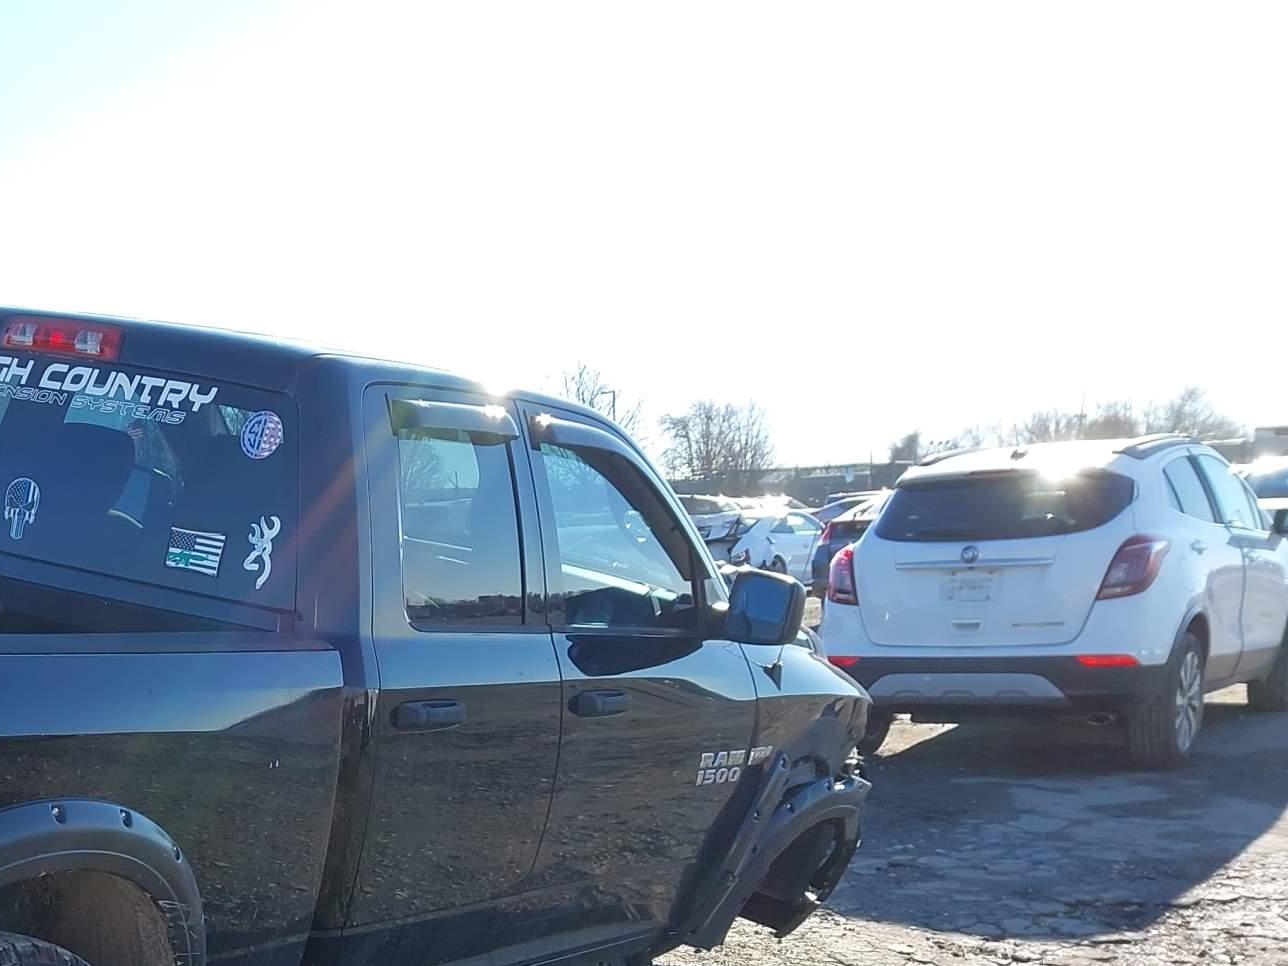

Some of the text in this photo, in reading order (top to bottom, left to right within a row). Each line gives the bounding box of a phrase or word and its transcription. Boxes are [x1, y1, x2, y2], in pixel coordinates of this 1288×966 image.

[38, 362, 219, 412] COUNTRY
[71, 395, 187, 425] SYSTEMS
[699, 750, 746, 769] RAM
[696, 767, 741, 787] 1500
